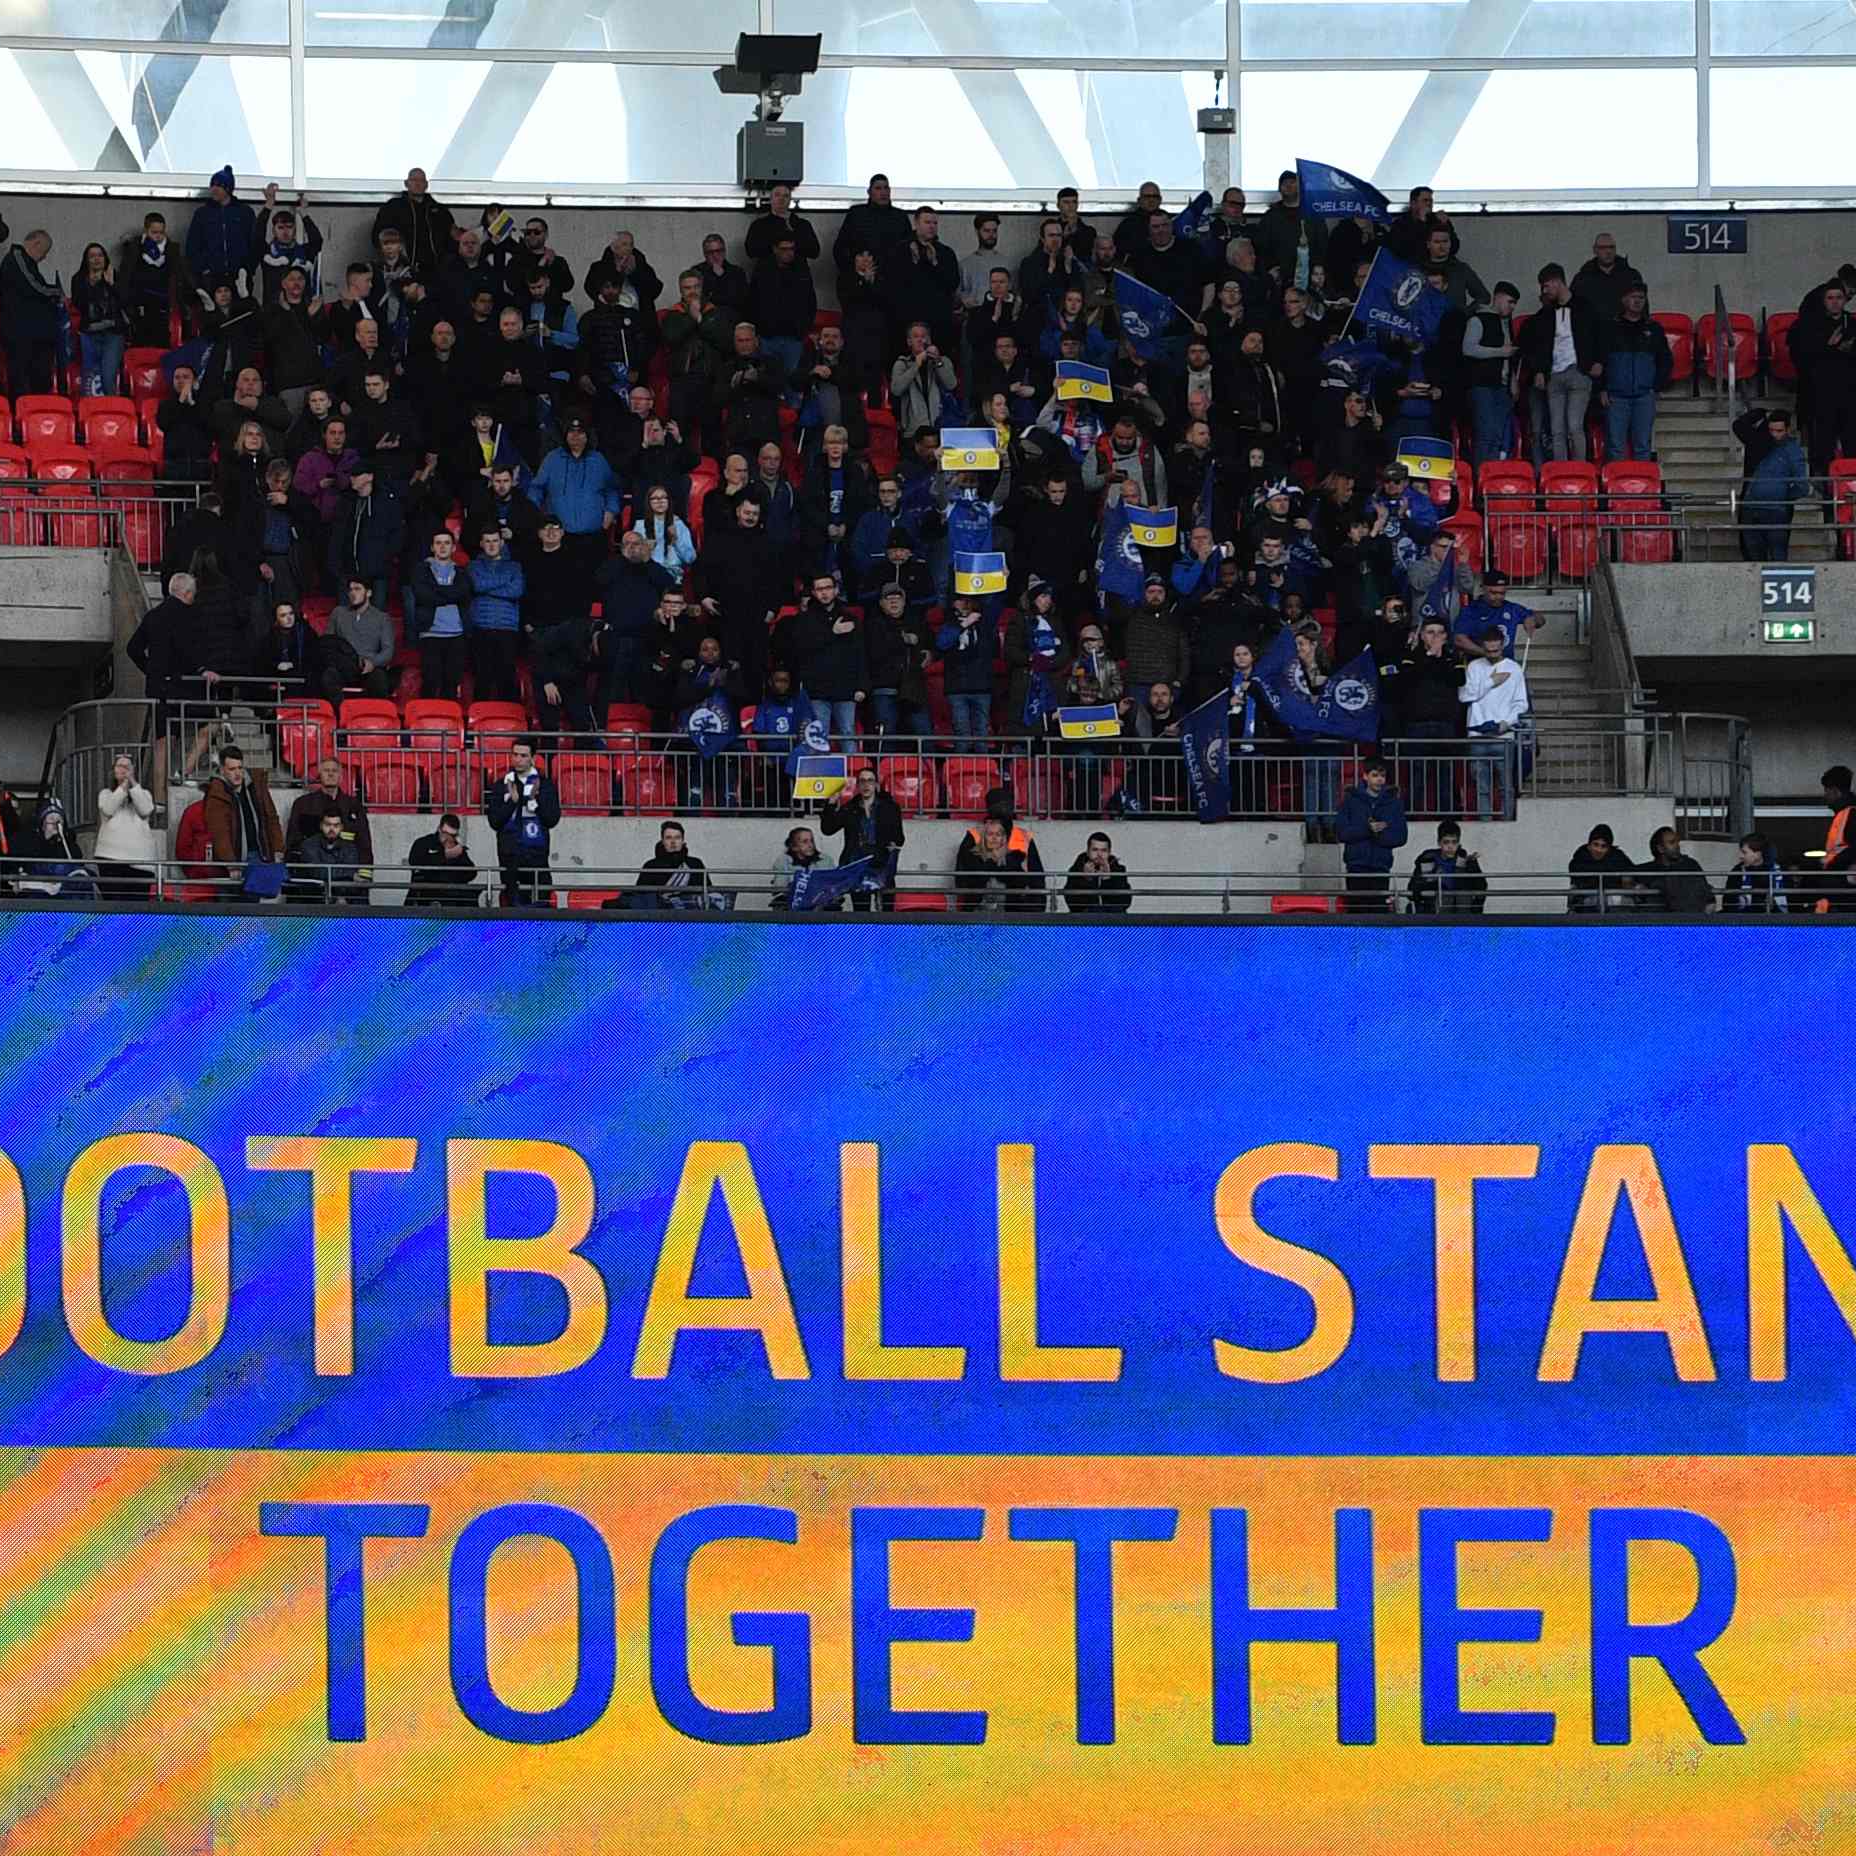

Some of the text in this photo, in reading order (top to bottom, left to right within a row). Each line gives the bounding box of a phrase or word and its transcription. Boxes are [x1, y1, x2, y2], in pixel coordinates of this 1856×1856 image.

[1684, 223, 1732, 250] 514
[1763, 582, 1812, 604] 514
[260, 1502, 1749, 1747] TOGETHER
